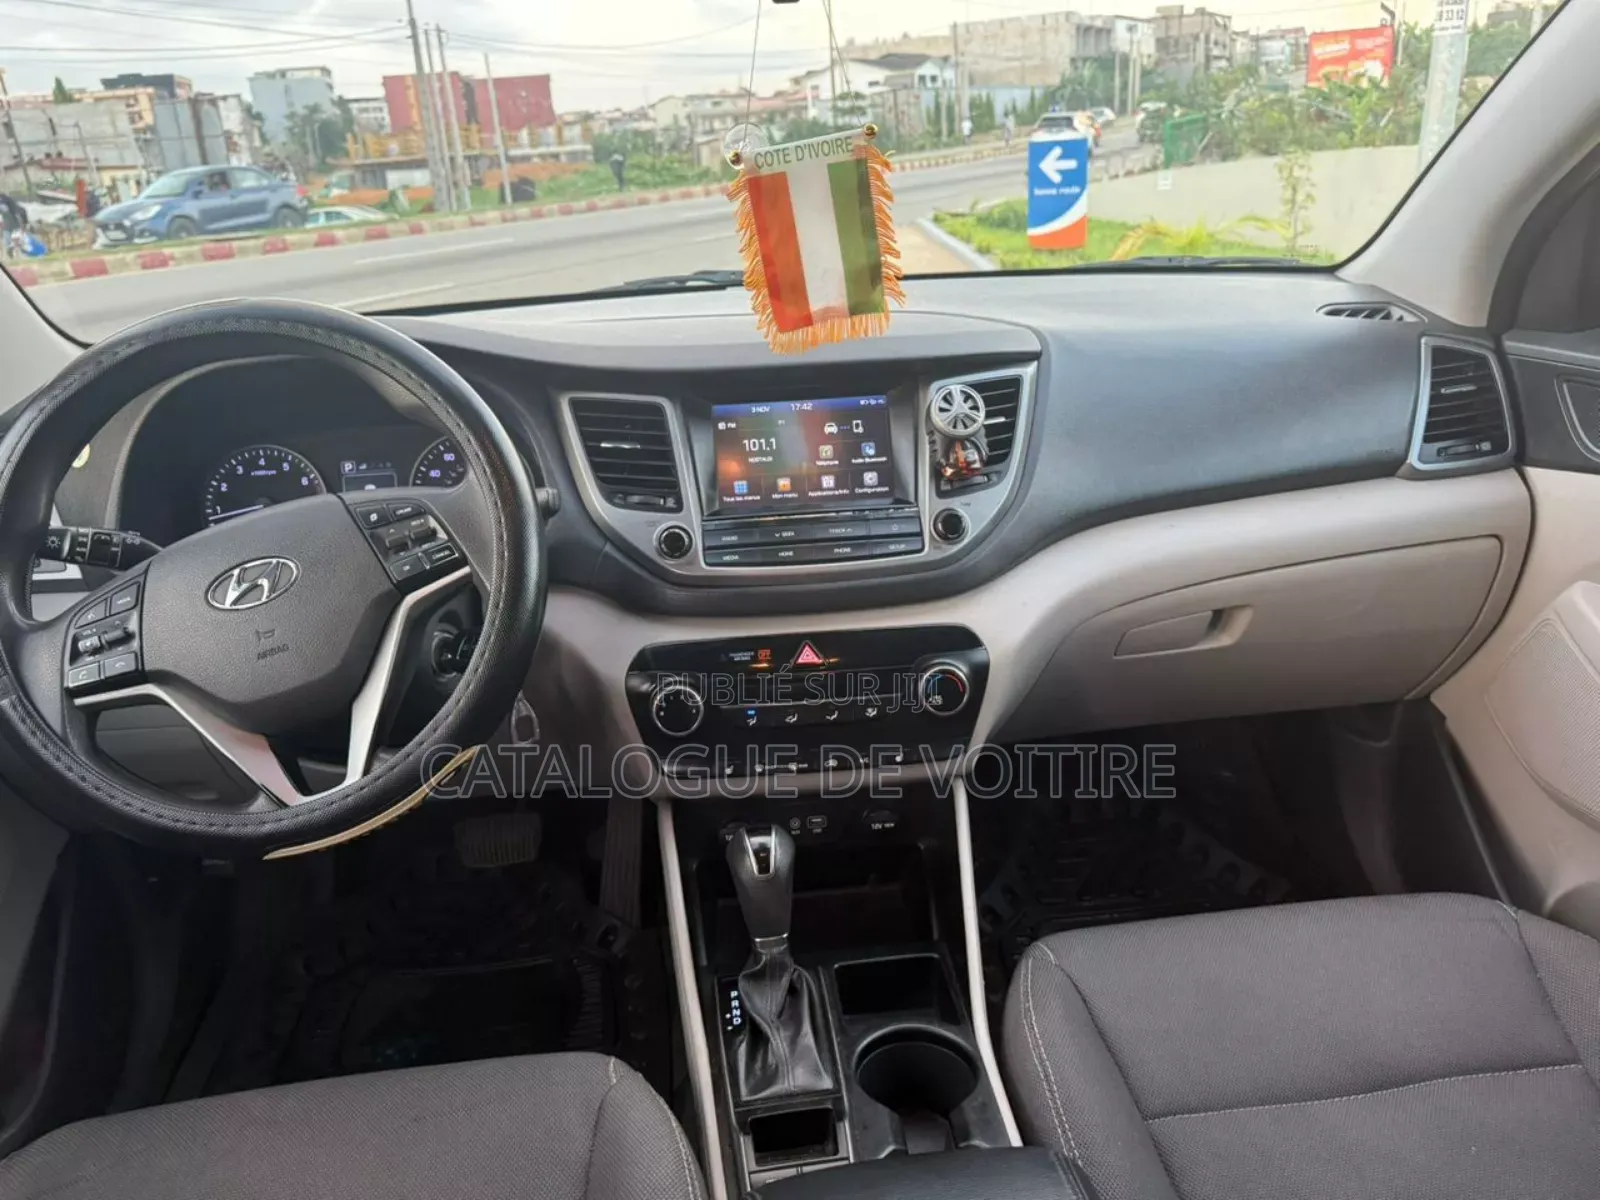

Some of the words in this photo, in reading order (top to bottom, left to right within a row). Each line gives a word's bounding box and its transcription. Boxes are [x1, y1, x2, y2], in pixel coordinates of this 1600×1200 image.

[754, 147, 791, 169] COTE
[795, 136, 853, 162] D'IVOIRE
[790, 403, 813, 411] 17:42
[743, 437, 776, 452] 101.1
[258, 457, 266, 466] 4
[235, 465, 244, 475] 3
[344, 462, 353, 472] P
[220, 482, 228, 492] 2
[730, 990, 738, 999] P
[731, 999, 740, 1008] R
[732, 1008, 740, 1017] N
[733, 1017, 741, 1025] D
